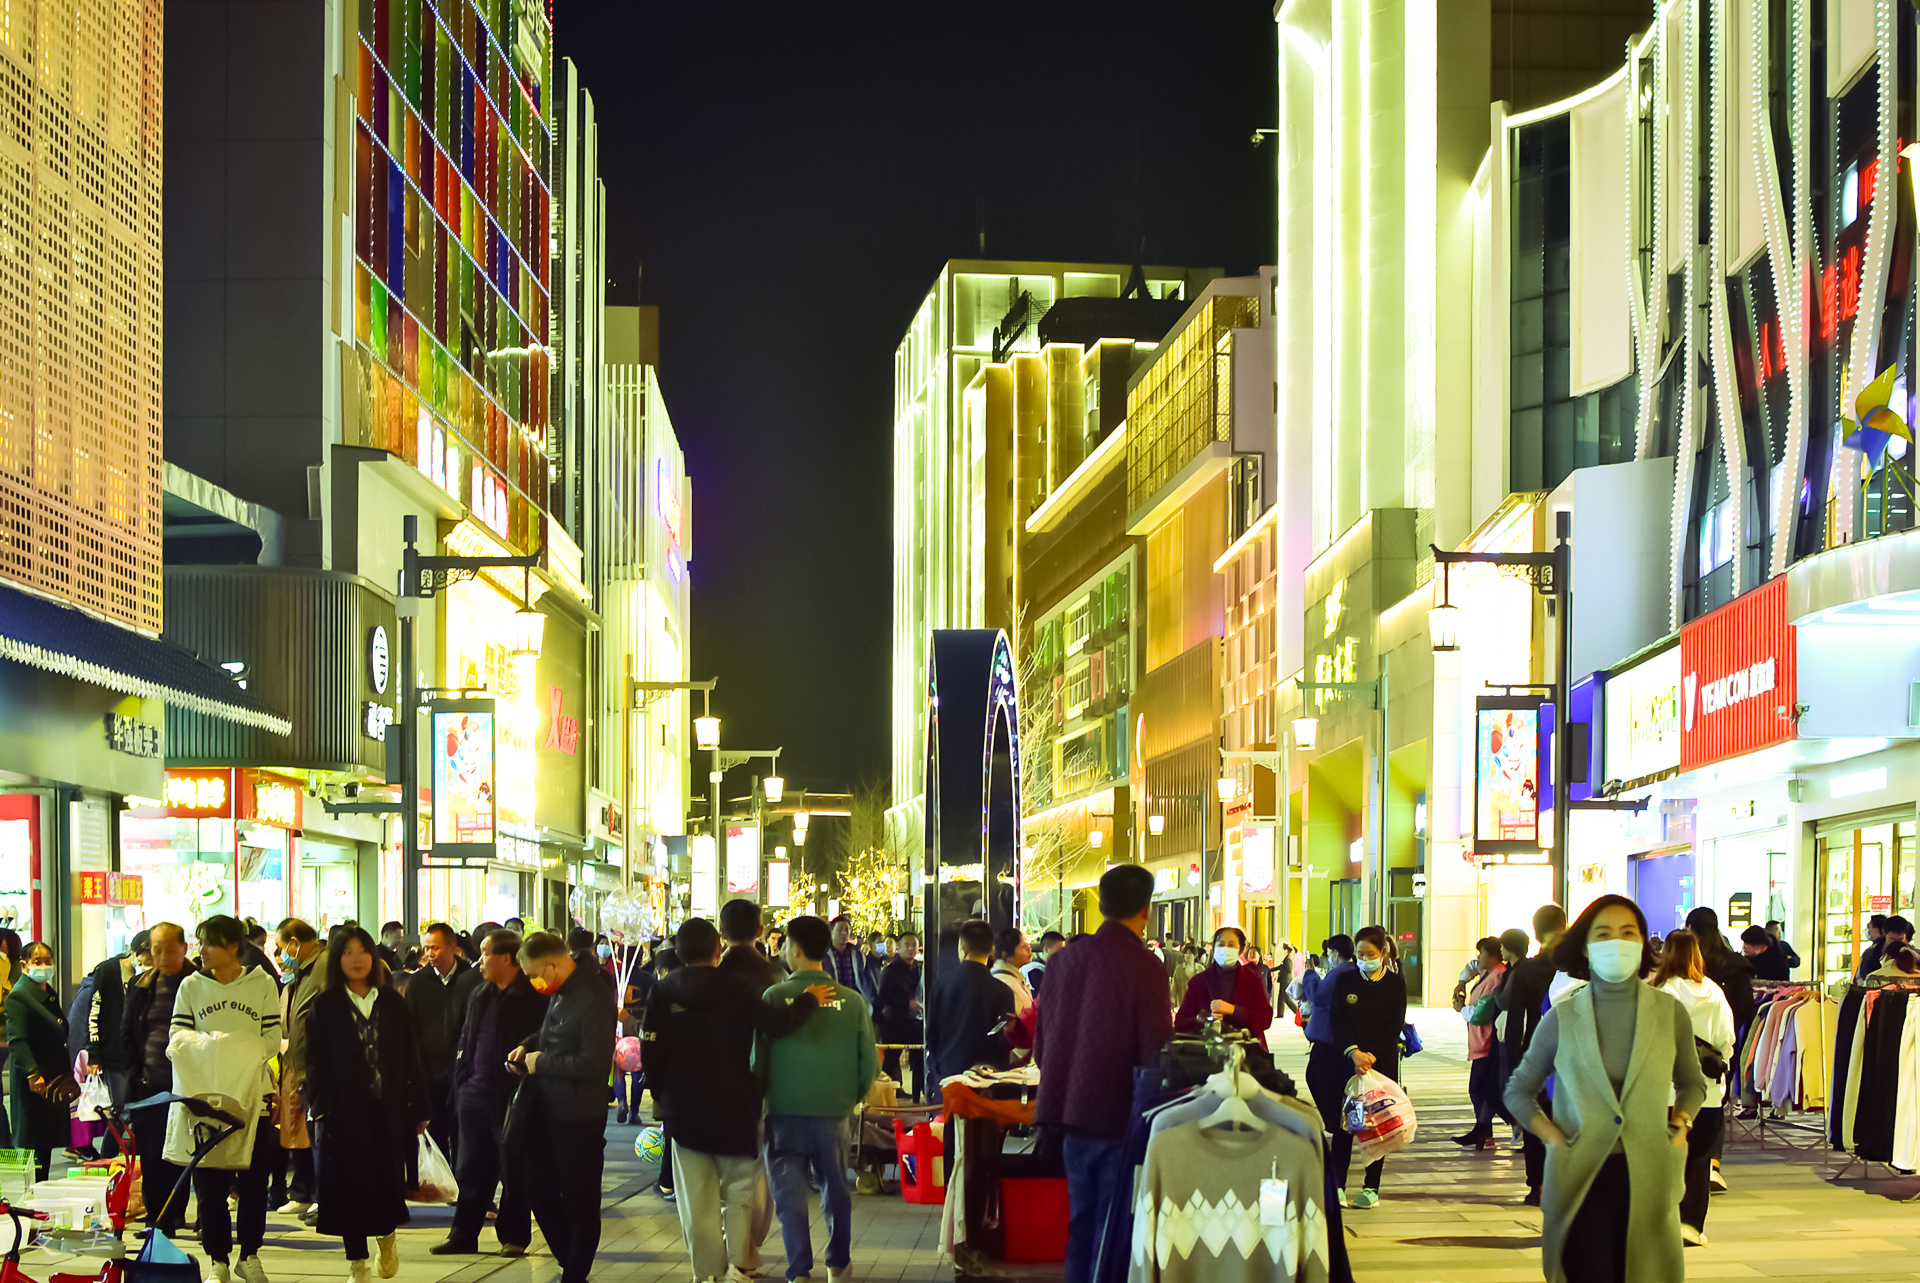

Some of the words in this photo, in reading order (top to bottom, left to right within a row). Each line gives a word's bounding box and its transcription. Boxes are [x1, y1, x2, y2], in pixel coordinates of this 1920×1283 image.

[1701, 668, 1749, 715] YEARCON
[82, 876, 103, 900] 栗王
[198, 1000, 227, 1020] Heur
